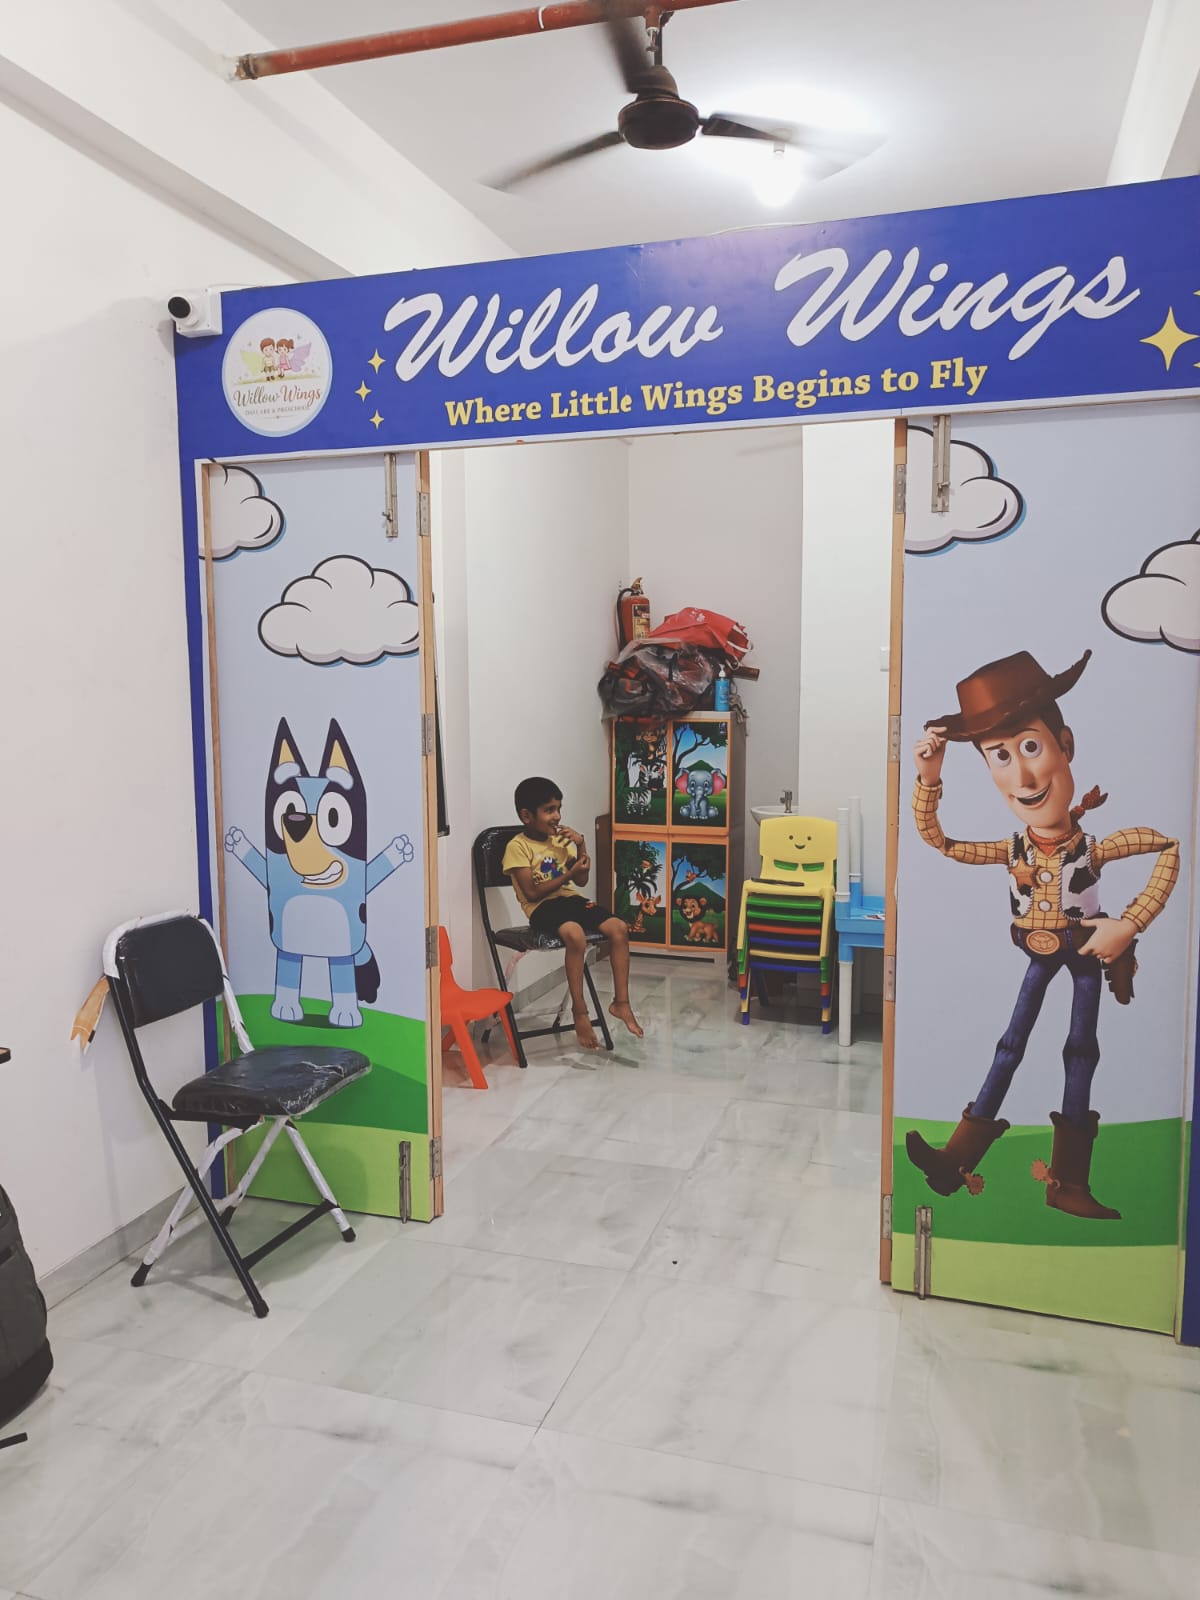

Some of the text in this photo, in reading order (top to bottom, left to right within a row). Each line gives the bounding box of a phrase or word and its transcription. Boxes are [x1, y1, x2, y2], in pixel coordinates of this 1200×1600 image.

[384, 247, 1140, 383] Willow Wings
[233, 384, 321, 408] Willow Wings
[445, 357, 988, 427] Where Little Wings Begins to Fly
